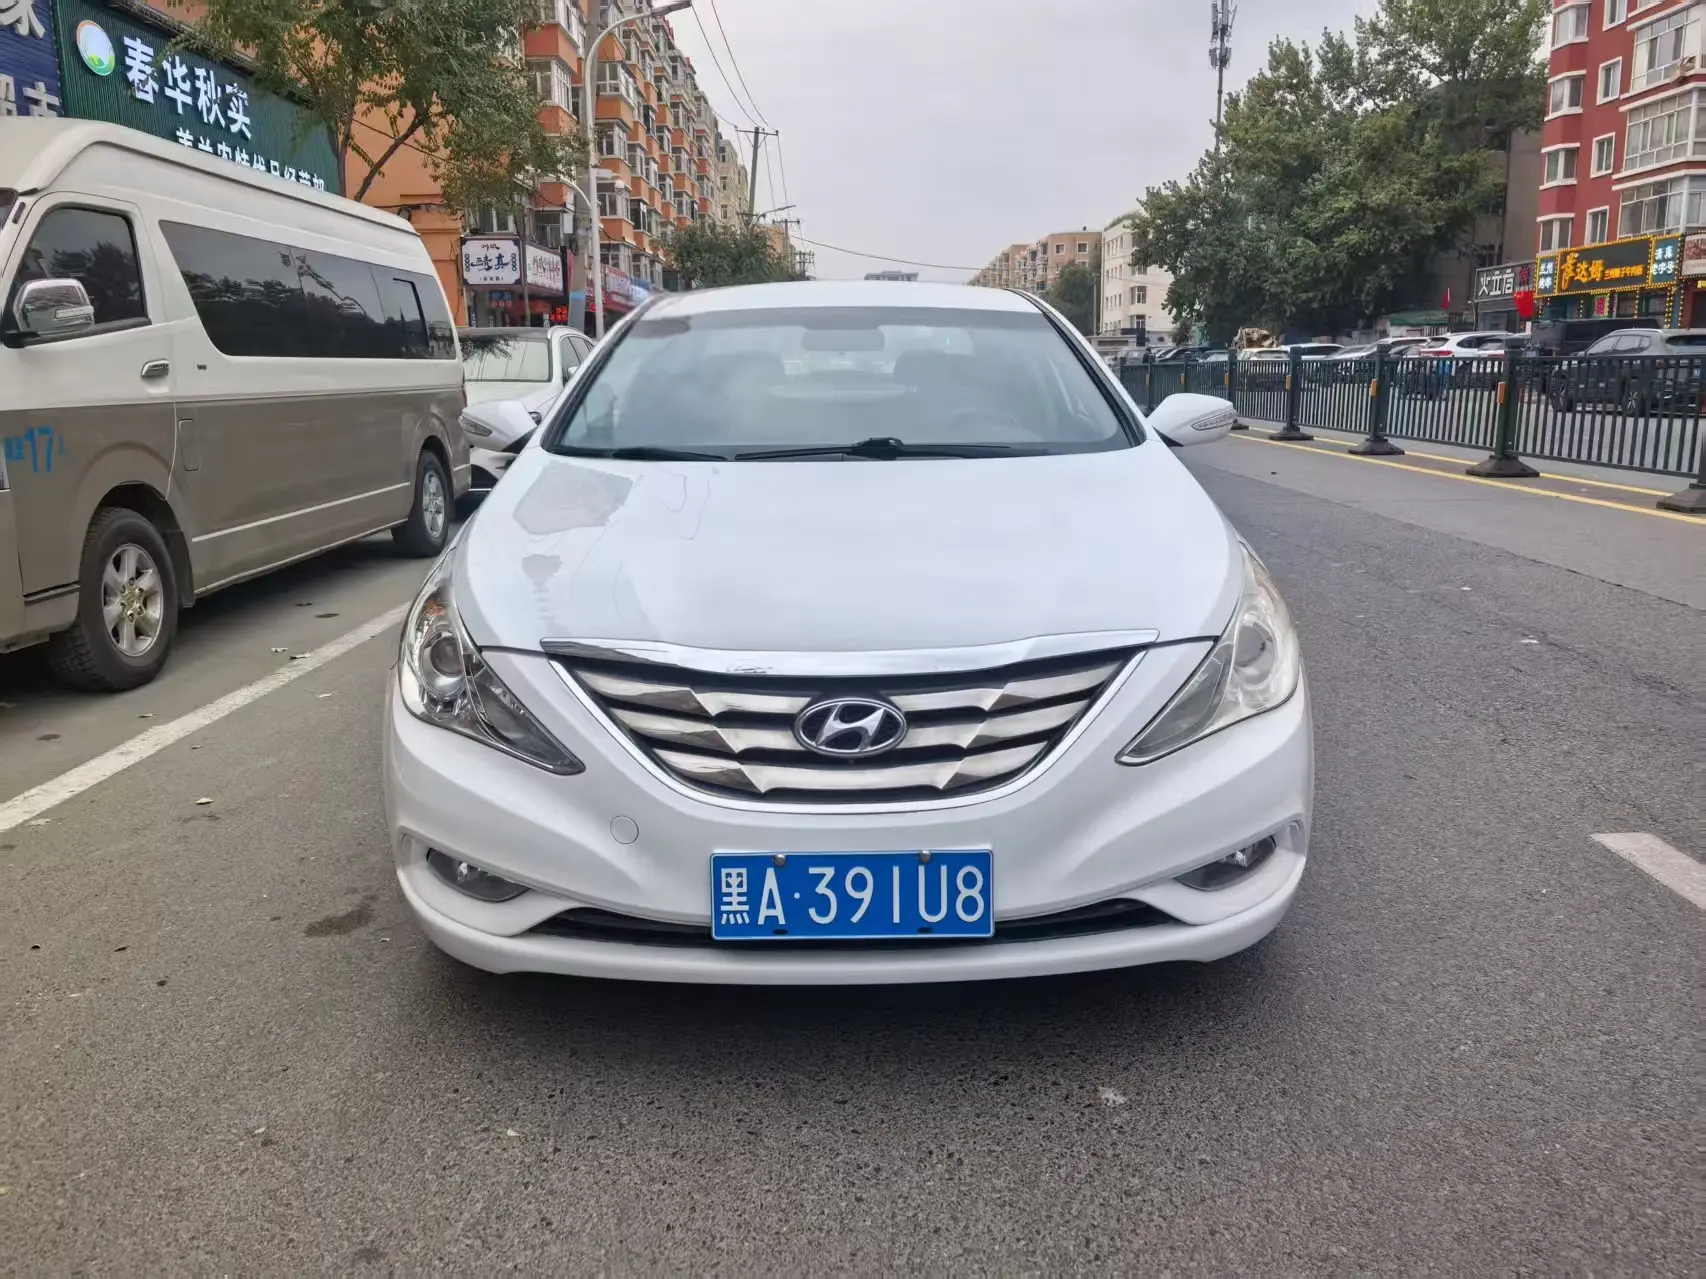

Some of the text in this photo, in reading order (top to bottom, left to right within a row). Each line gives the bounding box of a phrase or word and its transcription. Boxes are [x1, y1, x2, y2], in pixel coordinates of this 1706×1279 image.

[123, 36, 252, 140] 春华秋实
[720, 864, 985, 925] 黑A·391U8
